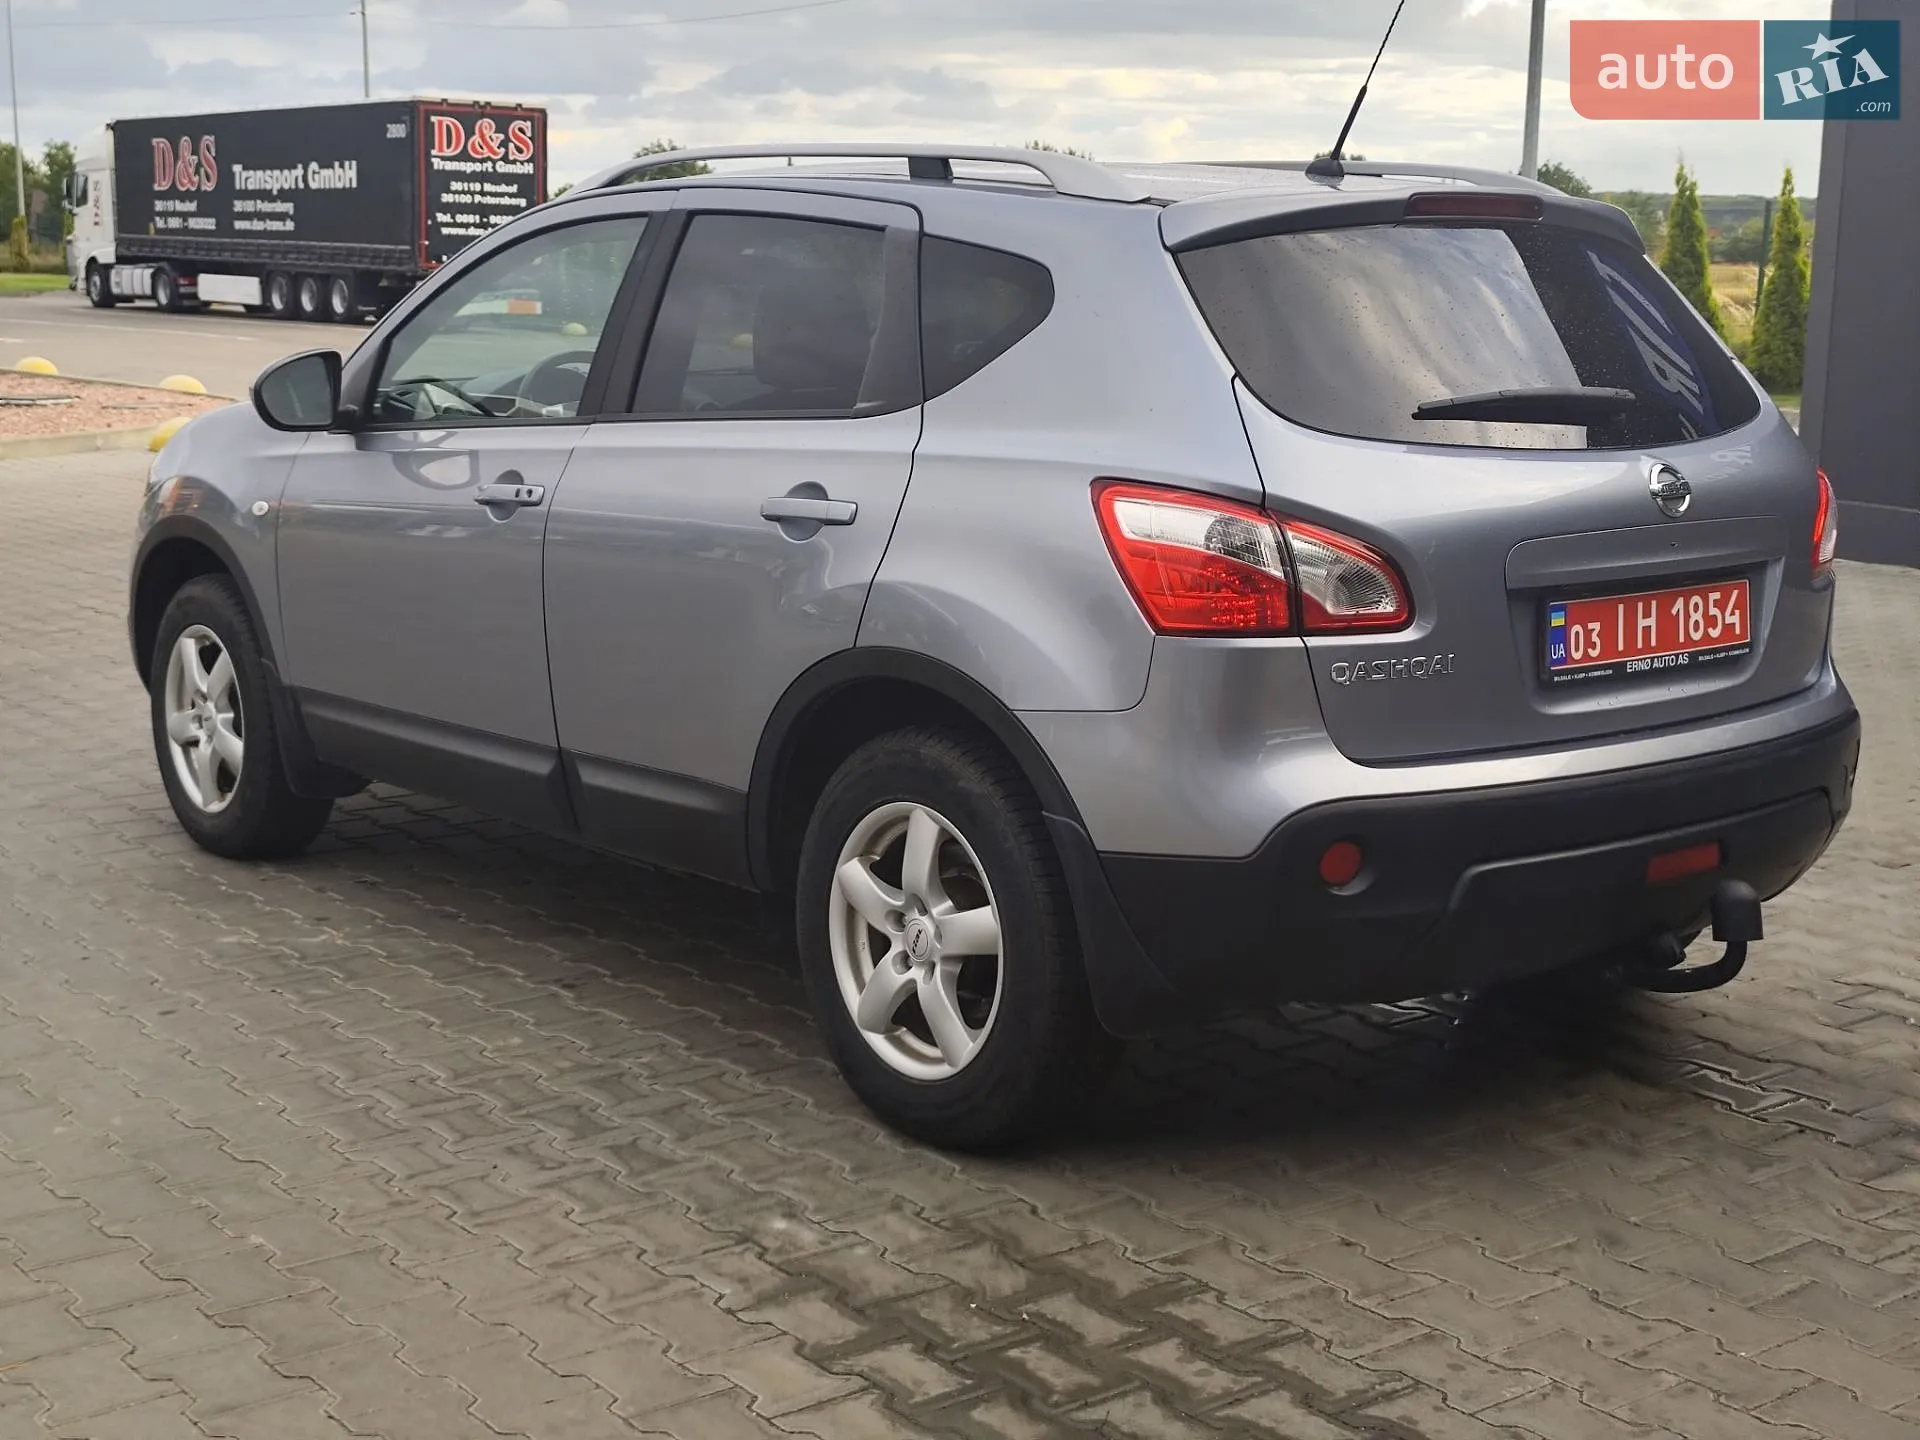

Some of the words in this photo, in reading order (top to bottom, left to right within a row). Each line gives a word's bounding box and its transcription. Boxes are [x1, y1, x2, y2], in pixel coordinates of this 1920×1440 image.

[430, 115, 534, 161] D&S
[152, 134, 218, 192] D&S
[232, 163, 305, 195] Transport
[307, 160, 357, 189] GmbH
[431, 157, 494, 174] Transport
[495, 160, 534, 174] GmbH
[1570, 622, 1601, 660] 03
[1671, 589, 1740, 643] 1854
[1551, 643, 1566, 660] UA
[1652, 655, 1676, 669] AUTO
[1677, 652, 1689, 664] AS
[1330, 653, 1455, 685] QASHQAI
